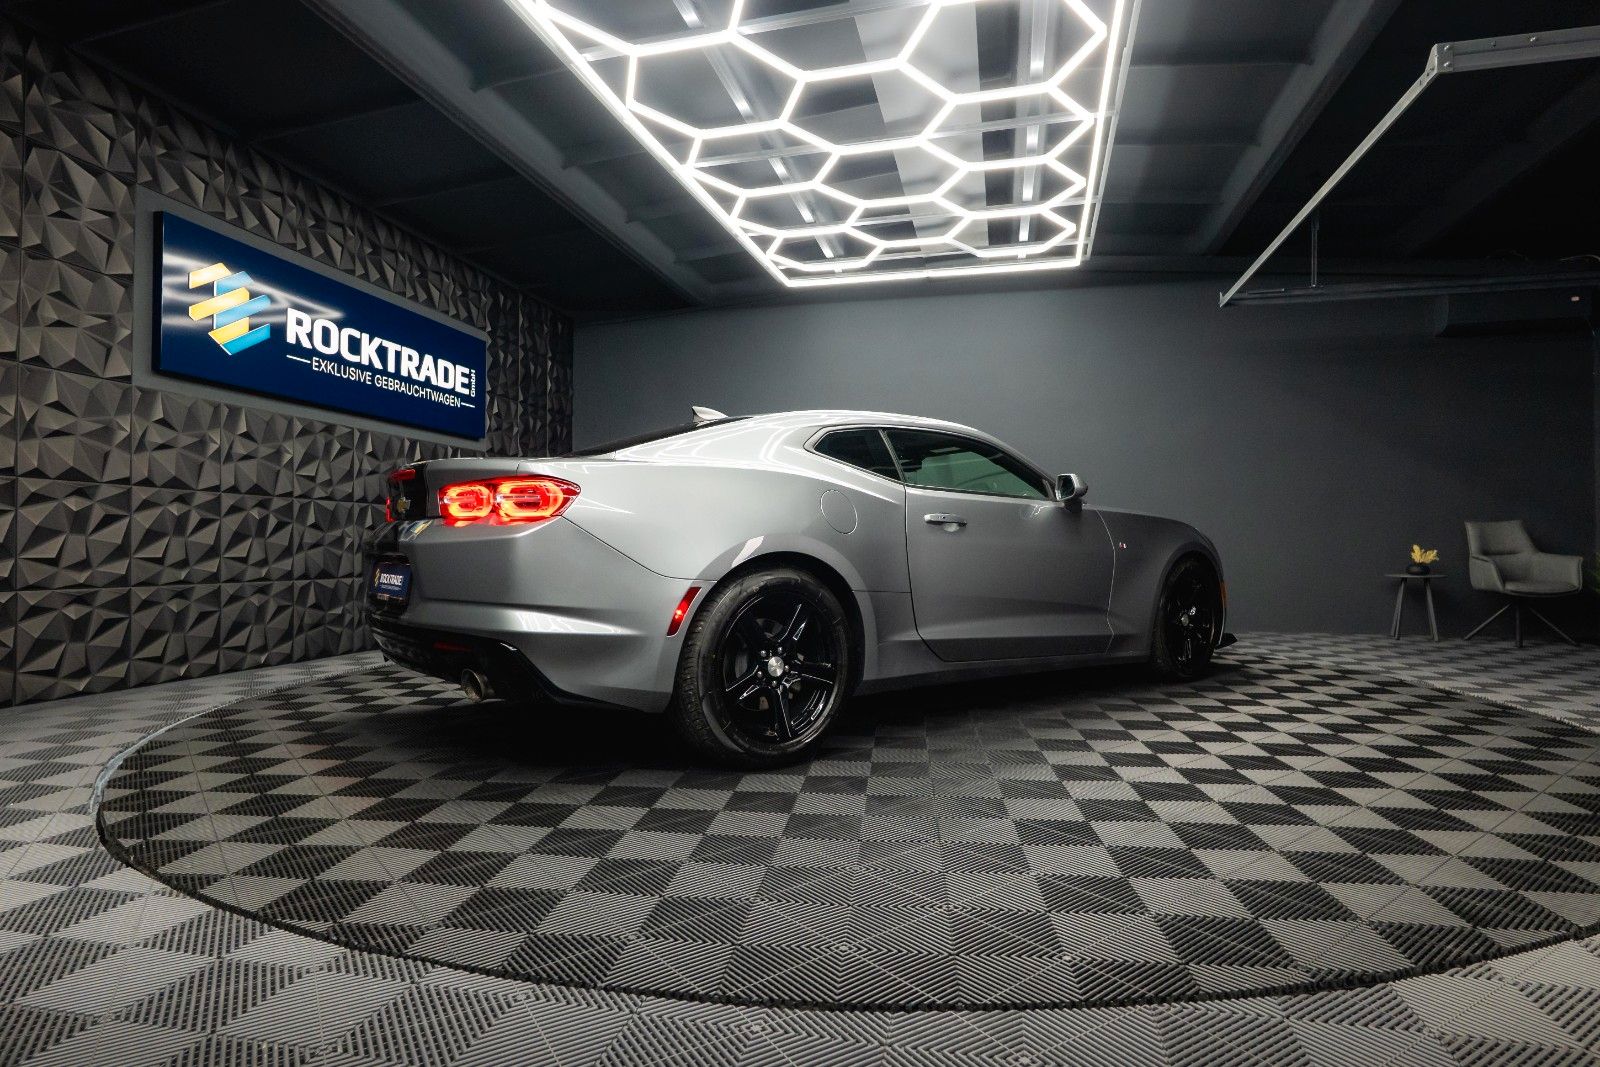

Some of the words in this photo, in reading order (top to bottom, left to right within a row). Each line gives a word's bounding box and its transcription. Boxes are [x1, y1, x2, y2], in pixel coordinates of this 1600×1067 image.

[286, 307, 470, 396] ROCKTRADE
[312, 356, 372, 385] EXKLUSIVE
[374, 374, 461, 408] GEBRAUCHTWAGEN
